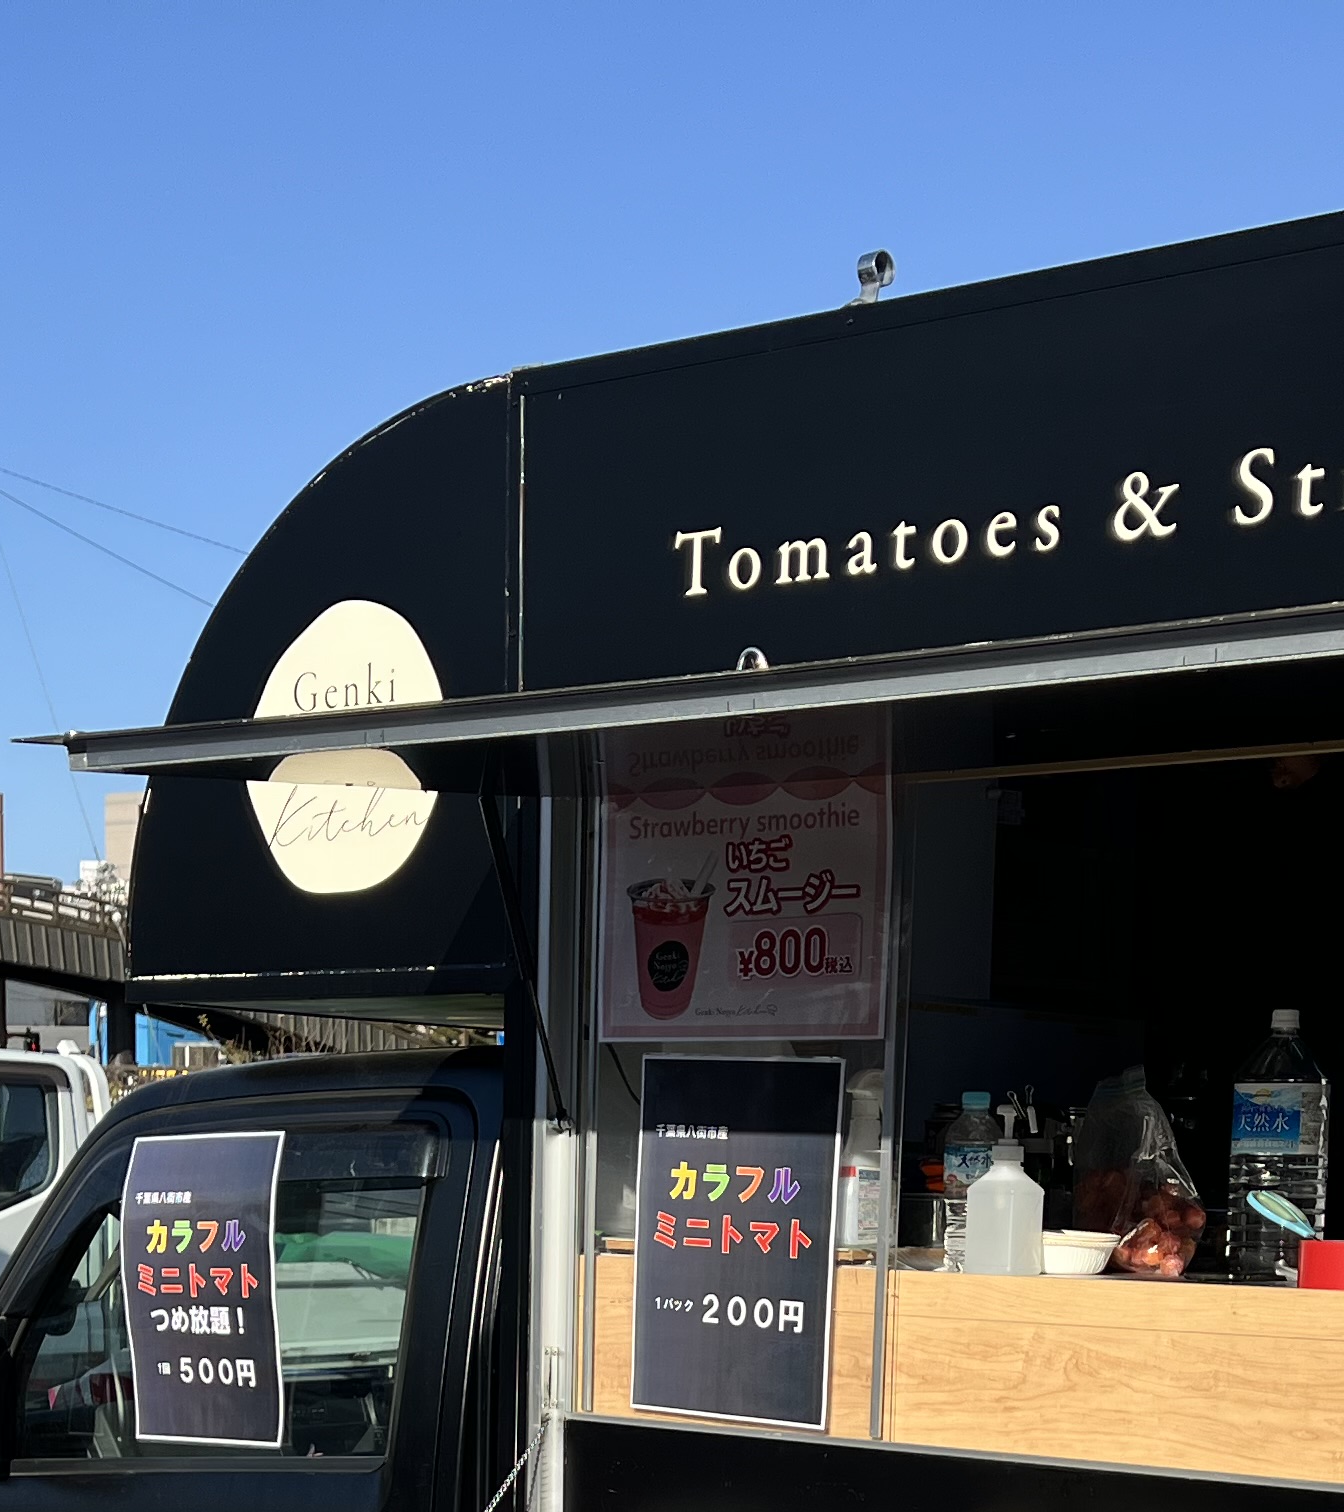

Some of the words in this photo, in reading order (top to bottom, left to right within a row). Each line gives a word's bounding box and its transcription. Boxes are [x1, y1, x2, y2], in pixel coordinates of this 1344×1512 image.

[672, 496, 1063, 597] Tomatoes
[1110, 470, 1178, 543] &
[293, 662, 398, 712] Genki
[268, 782, 430, 848] Kitchen
[629, 811, 751, 840] Strawberry
[757, 802, 861, 833] smoothie
[725, 834, 794, 873] いちご
[723, 871, 862, 917] スムージー
[1238, 1112, 1290, 1133] 天然水
[669, 1162, 802, 1205] カラフル
[146, 1219, 246, 1254] カラフル
[654, 1211, 814, 1261] ミニトマト
[137, 1263, 259, 1299] ミニトマト
[702, 1293, 805, 1335] 200円
[179, 1356, 257, 1388] 500円
